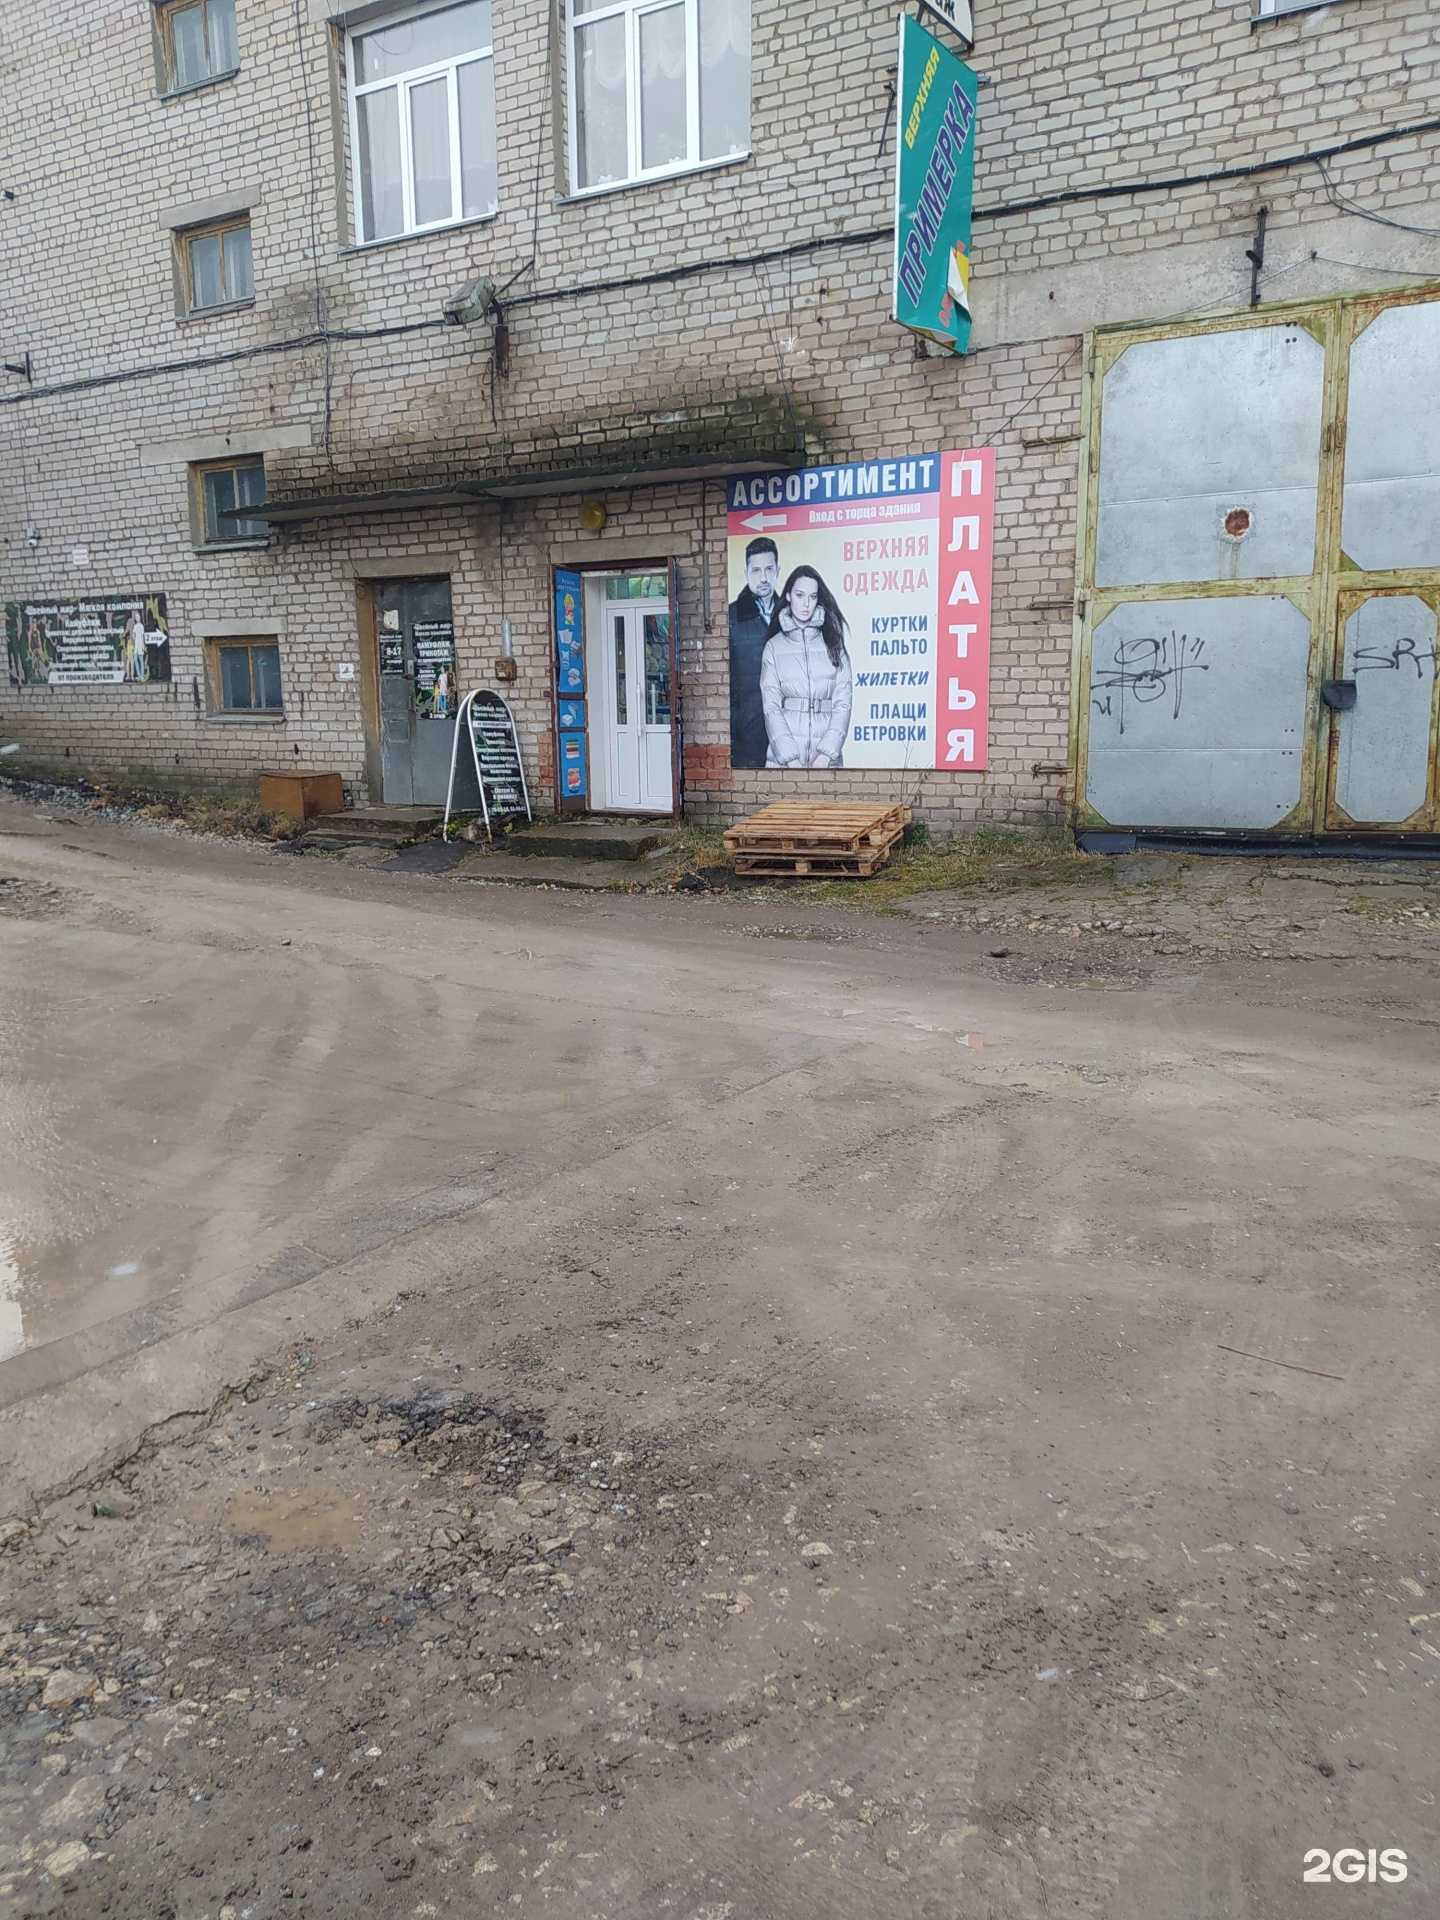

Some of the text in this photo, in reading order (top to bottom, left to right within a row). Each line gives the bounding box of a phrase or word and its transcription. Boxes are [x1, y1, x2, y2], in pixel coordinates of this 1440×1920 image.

[904, 46, 940, 150] ВЕРХНЯЯ
[899, 80, 975, 308] ПРИМЕРКА
[732, 459, 934, 506] АССОРТИМЕНТ
[809, 502, 921, 523] Вход с торца здания
[843, 535, 929, 561] ВЕРХНЯЯ
[843, 568, 929, 595] ОДЕЖДА
[944, 459, 982, 762] ПЛАТЬЯ
[871, 615, 928, 634] КУРТКИ
[870, 638, 928, 656] ПАЛЬТО
[855, 671, 929, 687] ЖИЛЕТКИ
[870, 703, 927, 721] ПЛАЩИ
[853, 725, 927, 742] ВЕТРОВКИ
